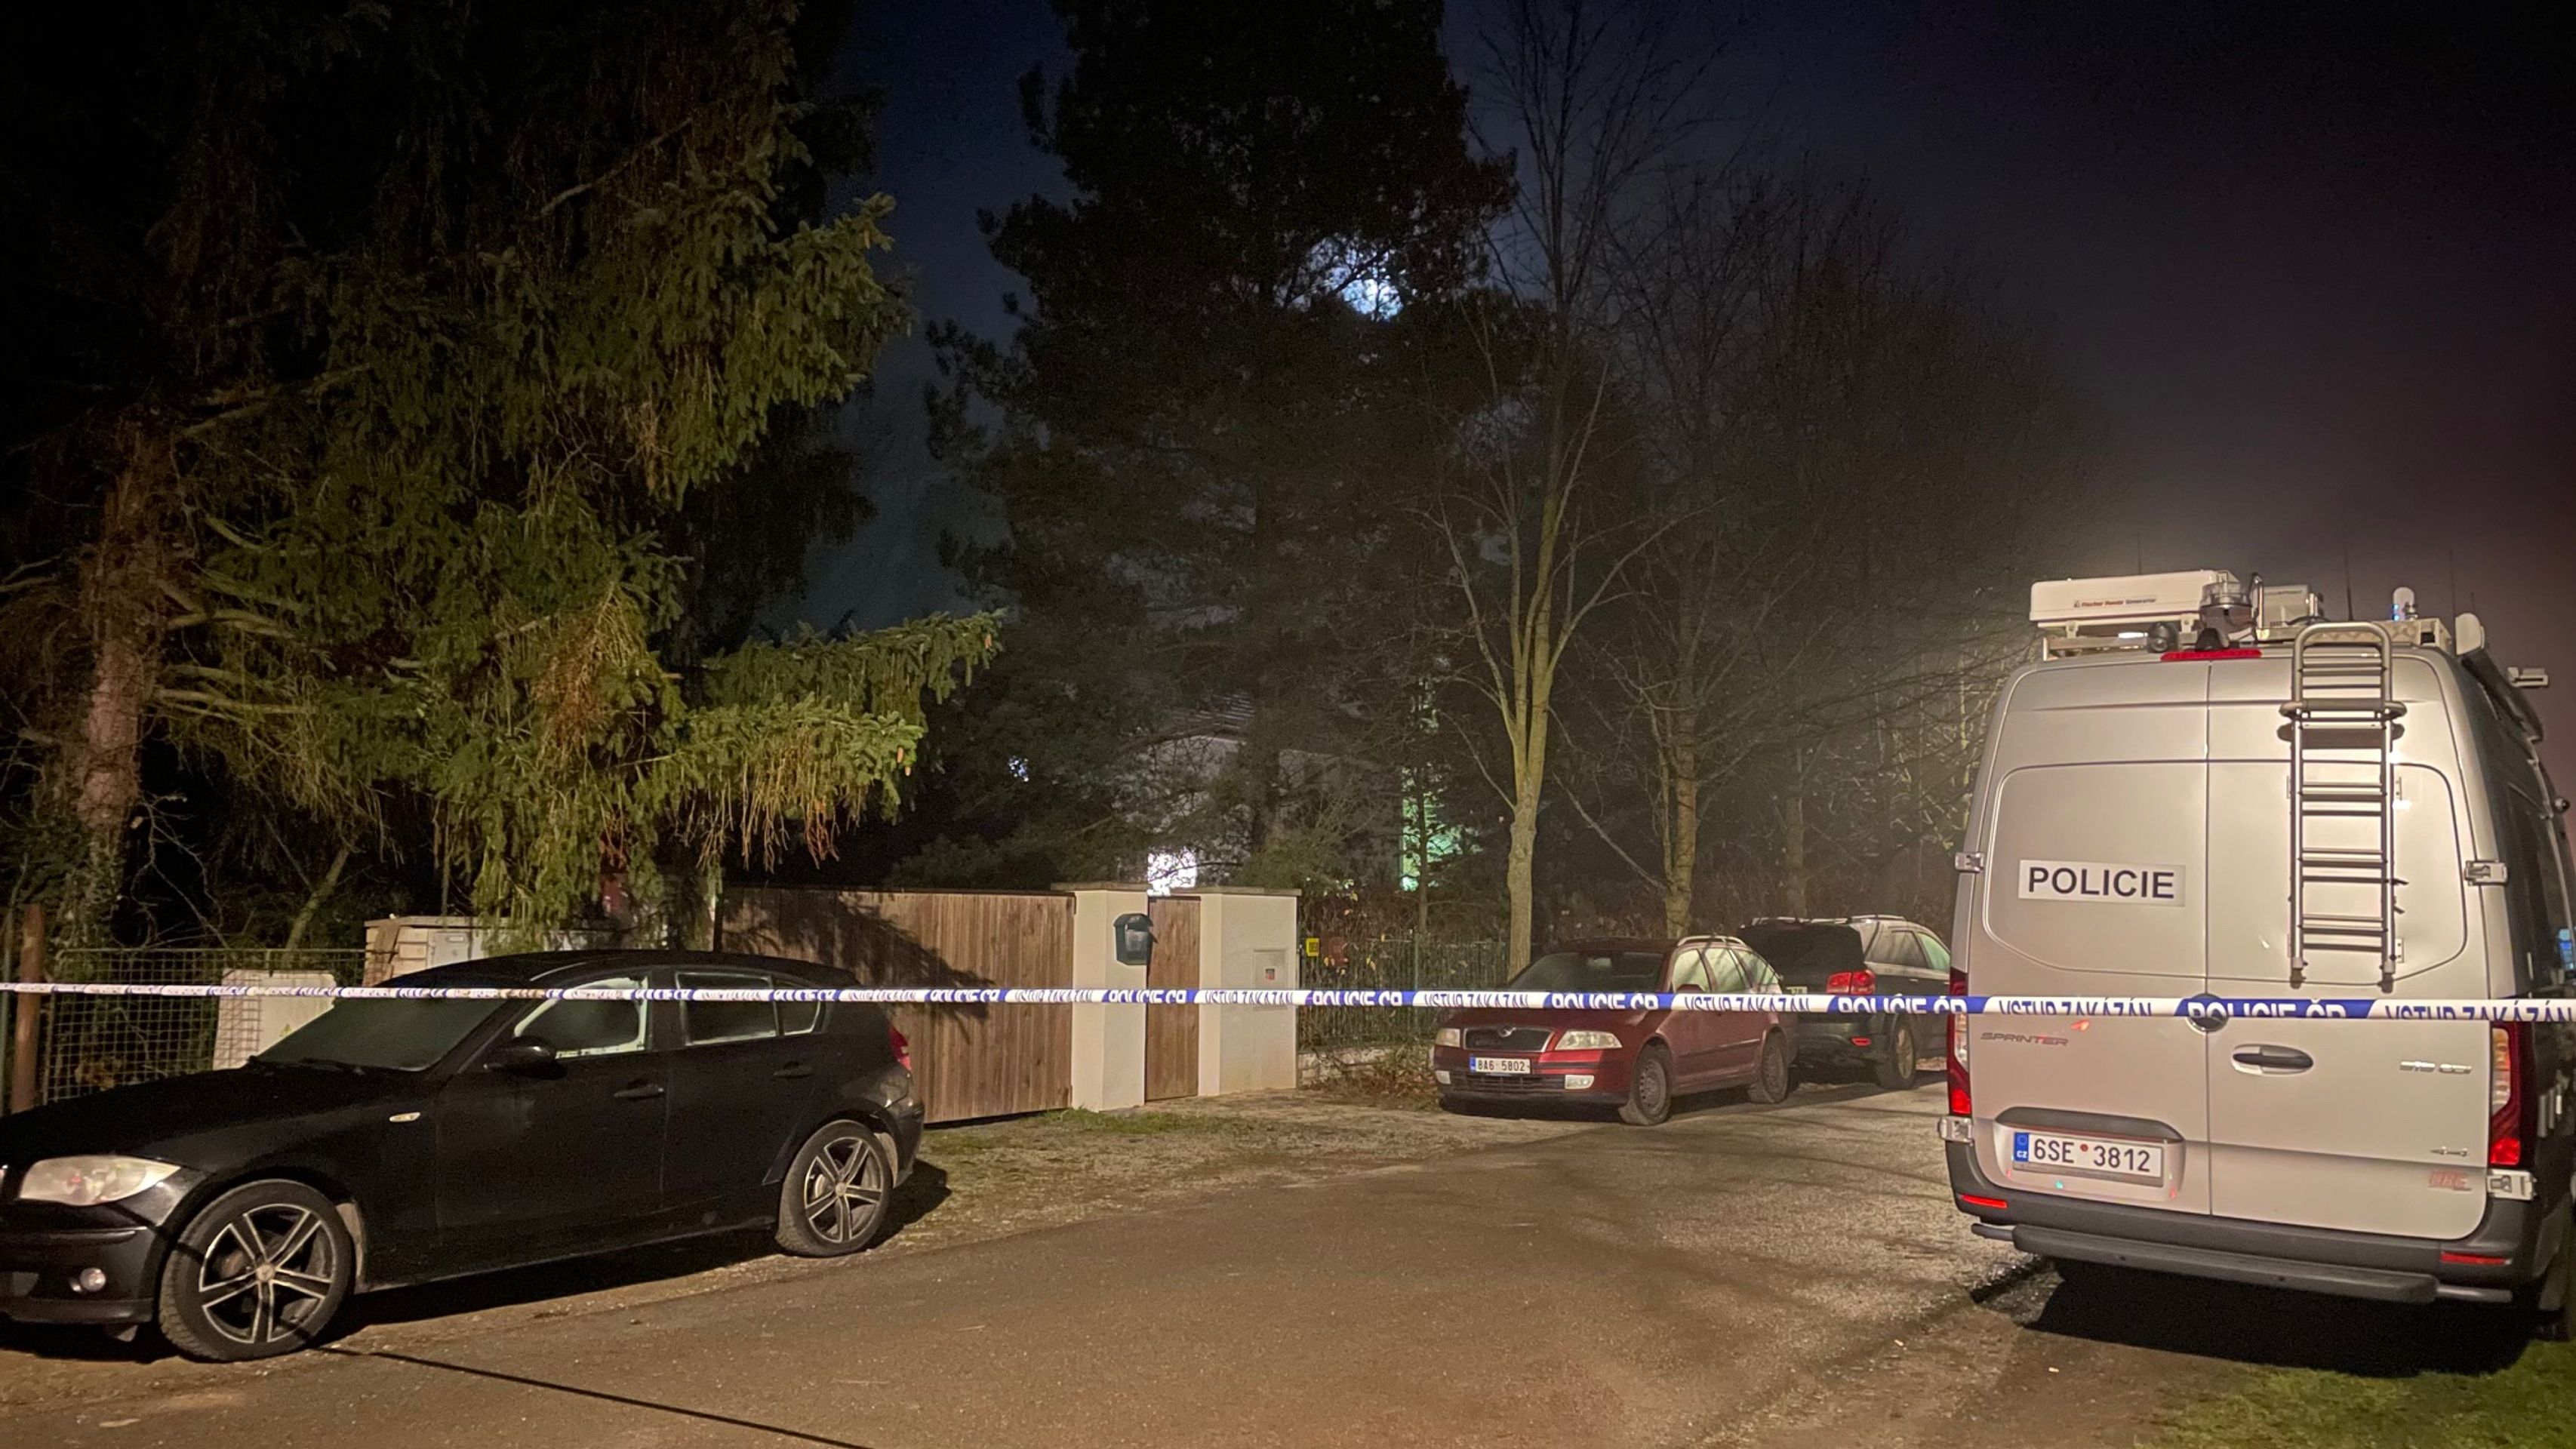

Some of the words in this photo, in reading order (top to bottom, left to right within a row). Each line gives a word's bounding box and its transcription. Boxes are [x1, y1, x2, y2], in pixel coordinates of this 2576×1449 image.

[2028, 866, 2174, 899] POLICIE
[1980, 1032, 2070, 1047] SPRINTER
[2016, 1149, 2028, 1159] CZ
[2033, 1137, 2075, 1164] 6SE
[2093, 1144, 2151, 1173] 3812
